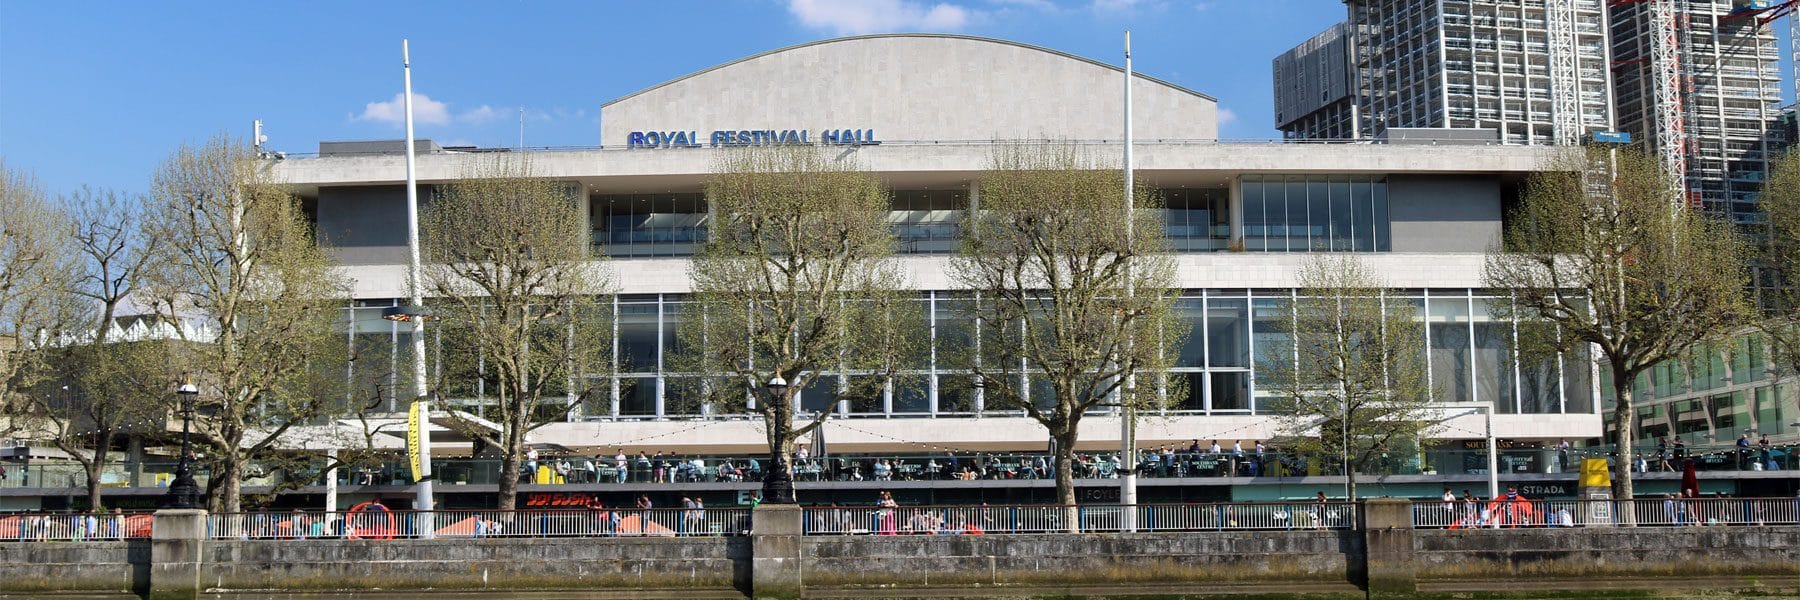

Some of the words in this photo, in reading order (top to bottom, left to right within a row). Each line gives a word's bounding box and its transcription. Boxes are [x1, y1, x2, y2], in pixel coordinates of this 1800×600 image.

[628, 131, 702, 149] ROYAL
[711, 129, 814, 147] FESTIVAL
[821, 128, 882, 146] HALL
[1522, 486, 1565, 495] STRADA
